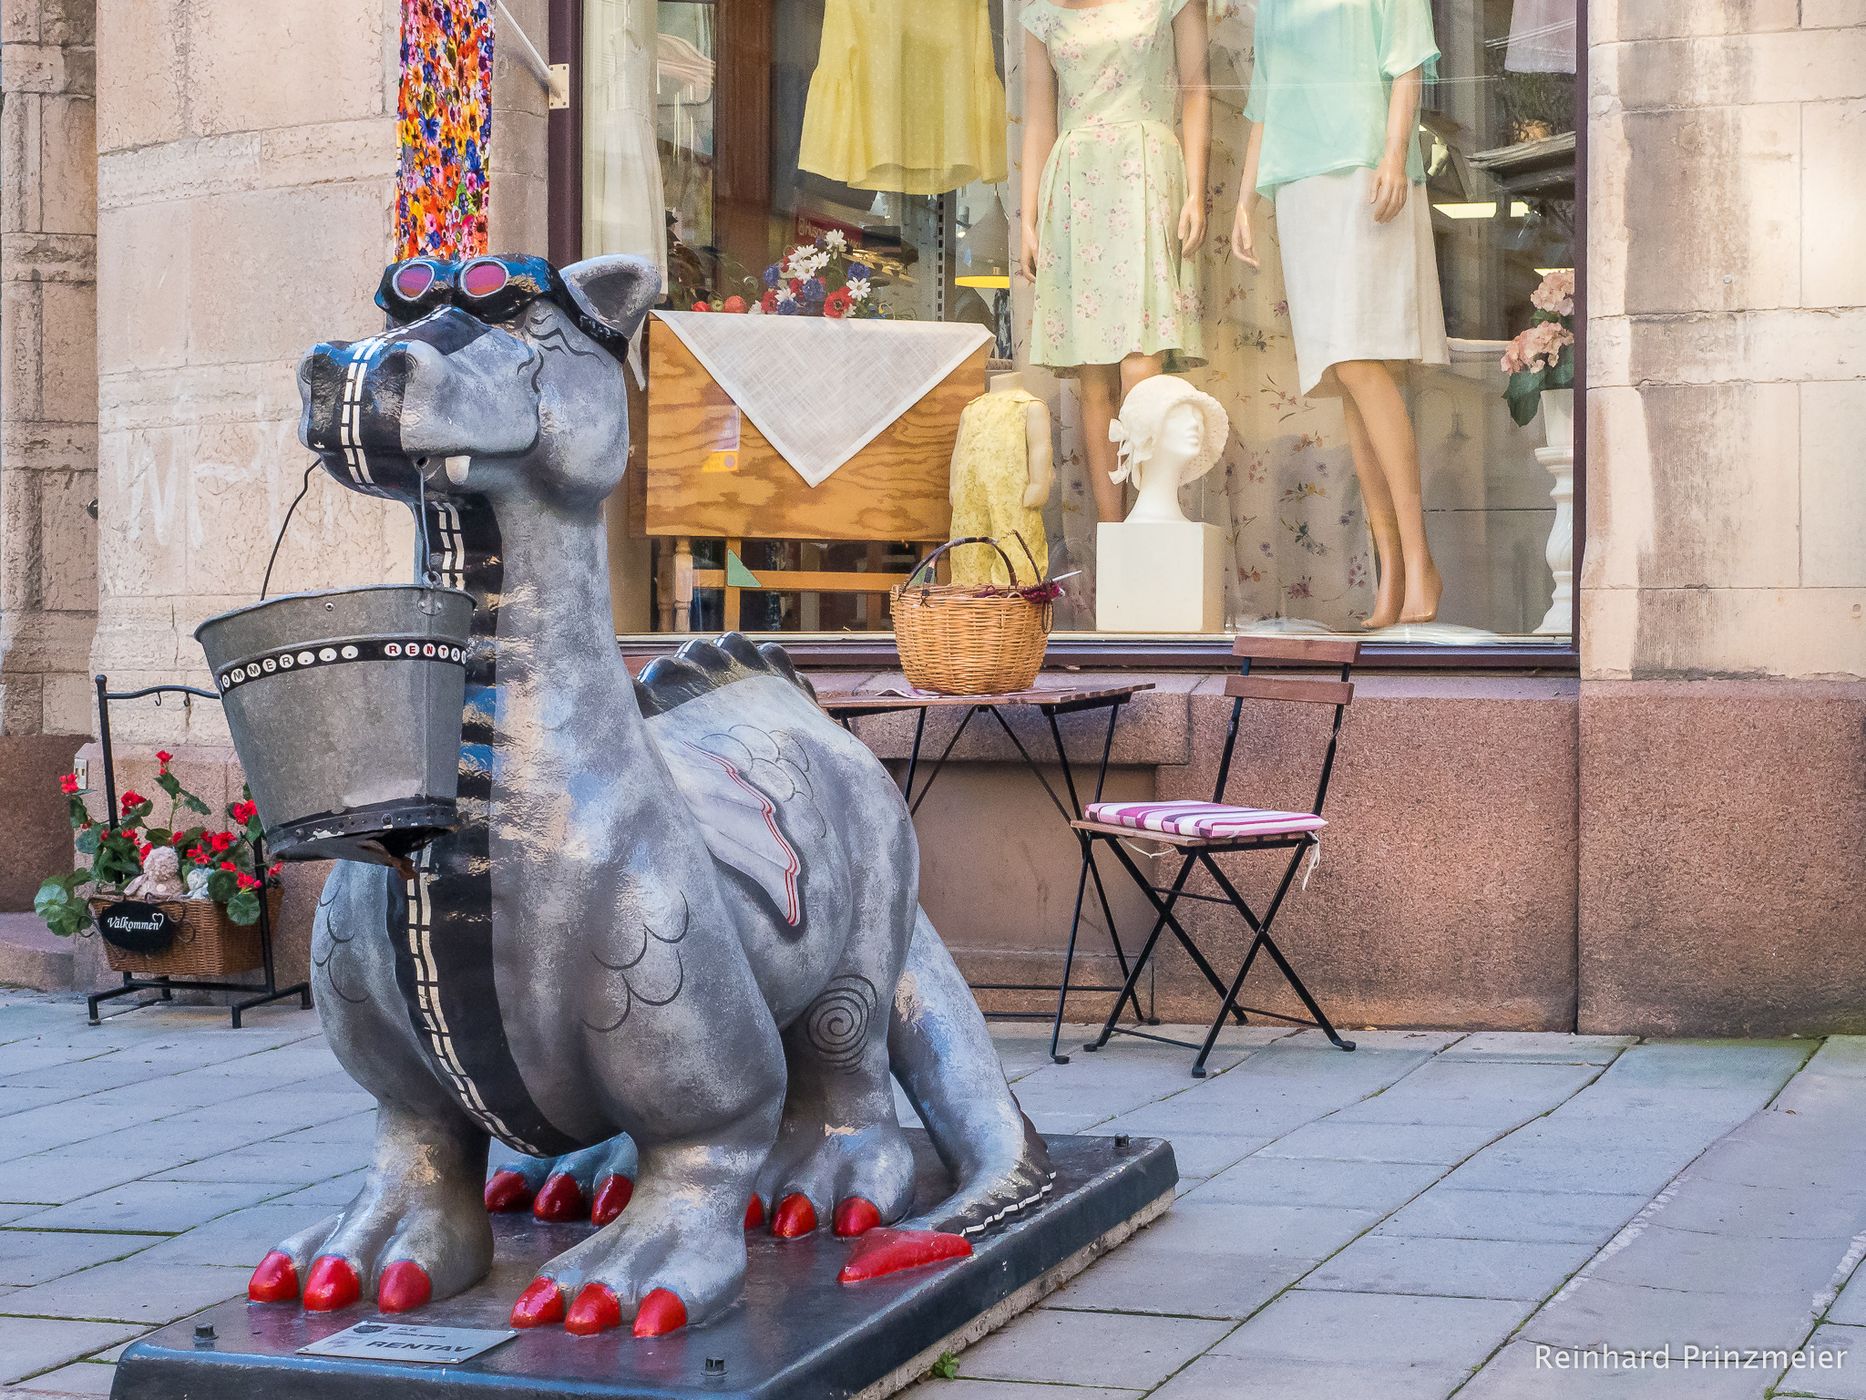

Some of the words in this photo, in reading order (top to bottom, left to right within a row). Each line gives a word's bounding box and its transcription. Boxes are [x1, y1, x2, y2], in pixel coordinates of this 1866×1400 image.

[221, 646, 357, 690] OMMER...
[386, 643, 466, 663] RENTA
[107, 916, 159, 932] Välkommen
[366, 1340, 474, 1352] RENTAV
